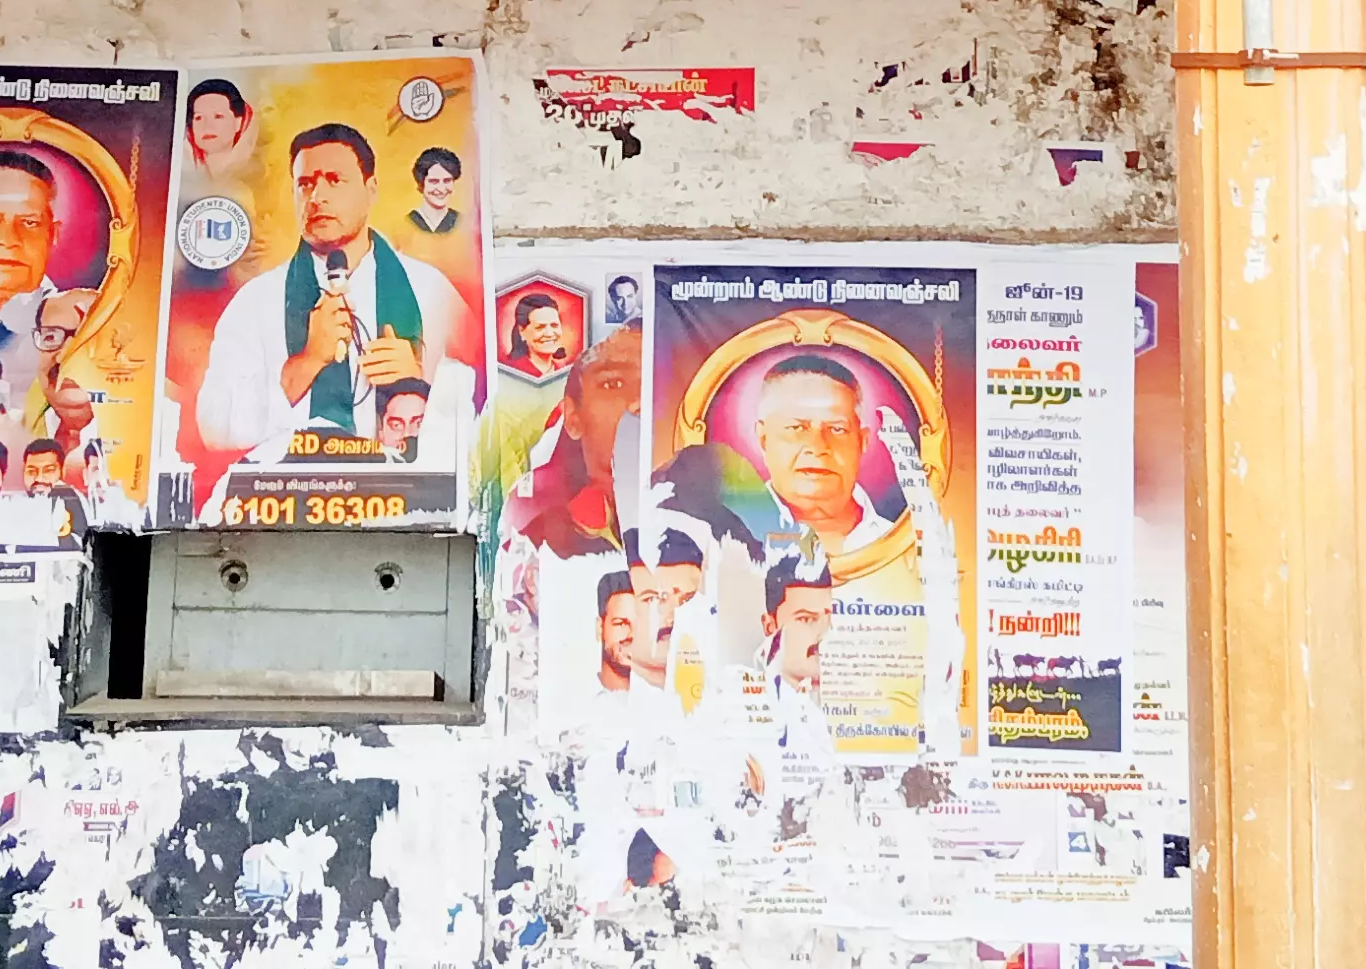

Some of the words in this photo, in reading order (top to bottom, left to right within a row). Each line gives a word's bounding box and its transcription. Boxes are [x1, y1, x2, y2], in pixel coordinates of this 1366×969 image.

[33, 78, 161, 104] நினைவஞ்சலி
[671, 276, 755, 302] மூன்றாம்
[758, 277, 829, 303] ஆண்டு
[830, 278, 960, 304] நினைவஞ்சலி
[986, 334, 1083, 353] லைவர்
[222, 495, 296, 526] 6101
[305, 496, 406, 526] 36308
